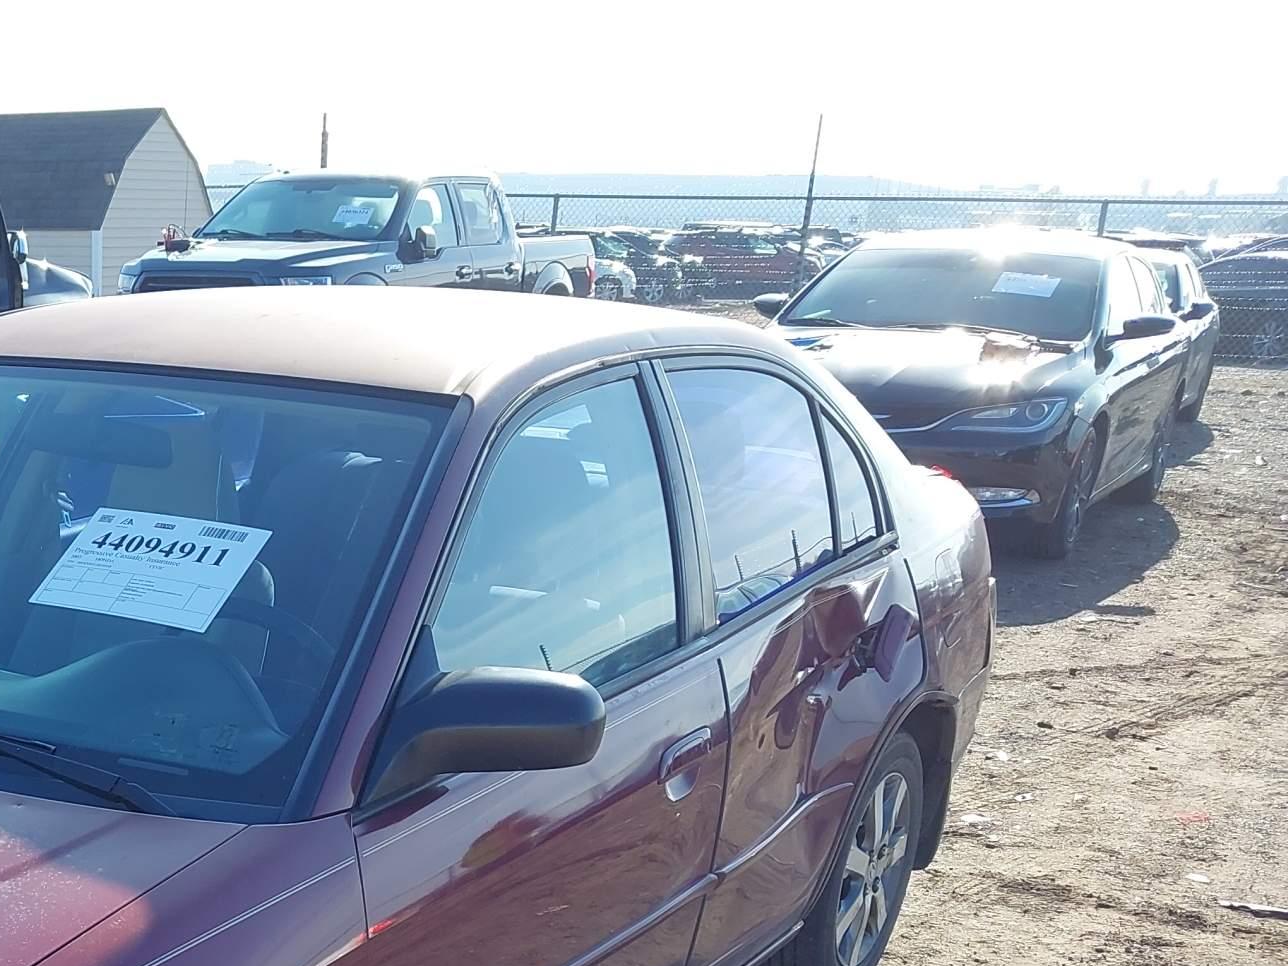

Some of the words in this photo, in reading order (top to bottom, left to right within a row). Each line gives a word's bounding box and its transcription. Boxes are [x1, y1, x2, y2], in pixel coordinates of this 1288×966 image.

[74, 547, 114, 558] Progressive
[114, 552, 145, 563] Casualty
[146, 556, 181, 567] Insurance
[91, 531, 231, 567] 44094911
